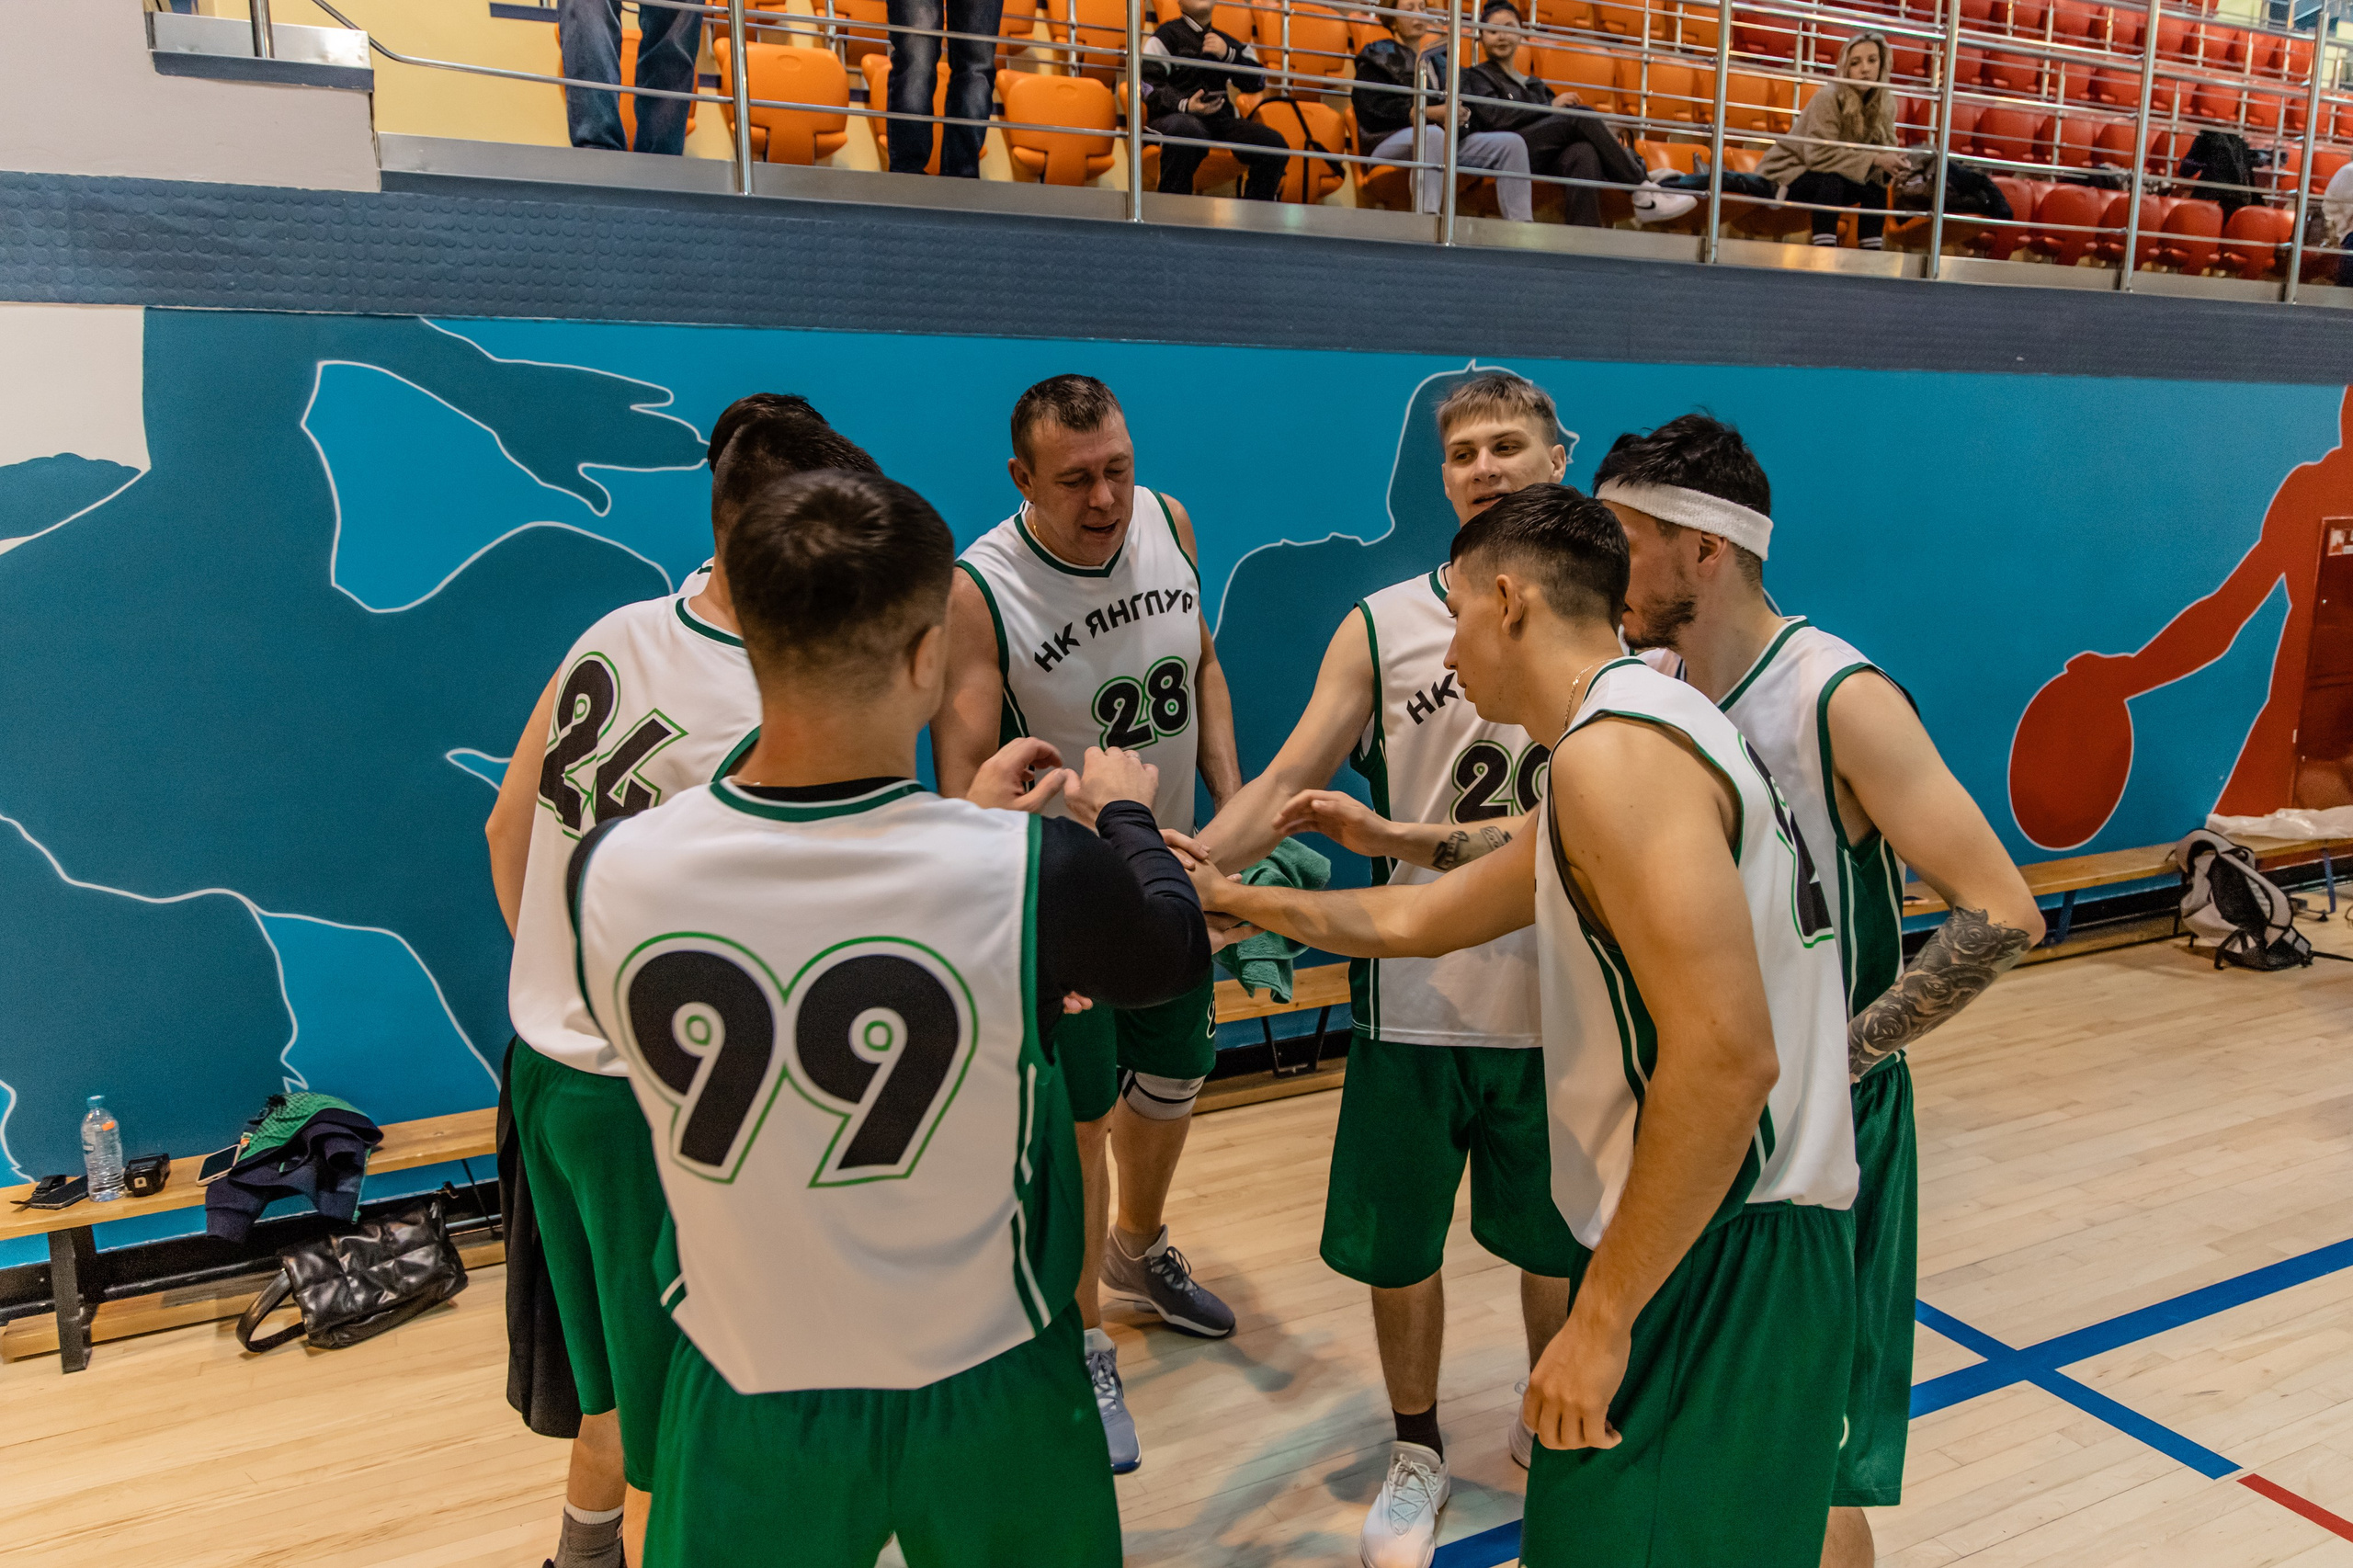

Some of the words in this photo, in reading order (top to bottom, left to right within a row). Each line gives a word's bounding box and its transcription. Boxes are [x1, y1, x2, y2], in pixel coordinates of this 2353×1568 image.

[1033, 621, 1081, 674] НК
[1085, 588, 1194, 640] ЯНГПУР
[1091, 655, 1191, 753] 28
[1405, 671, 1460, 726] НК
[613, 930, 979, 1189] 99
